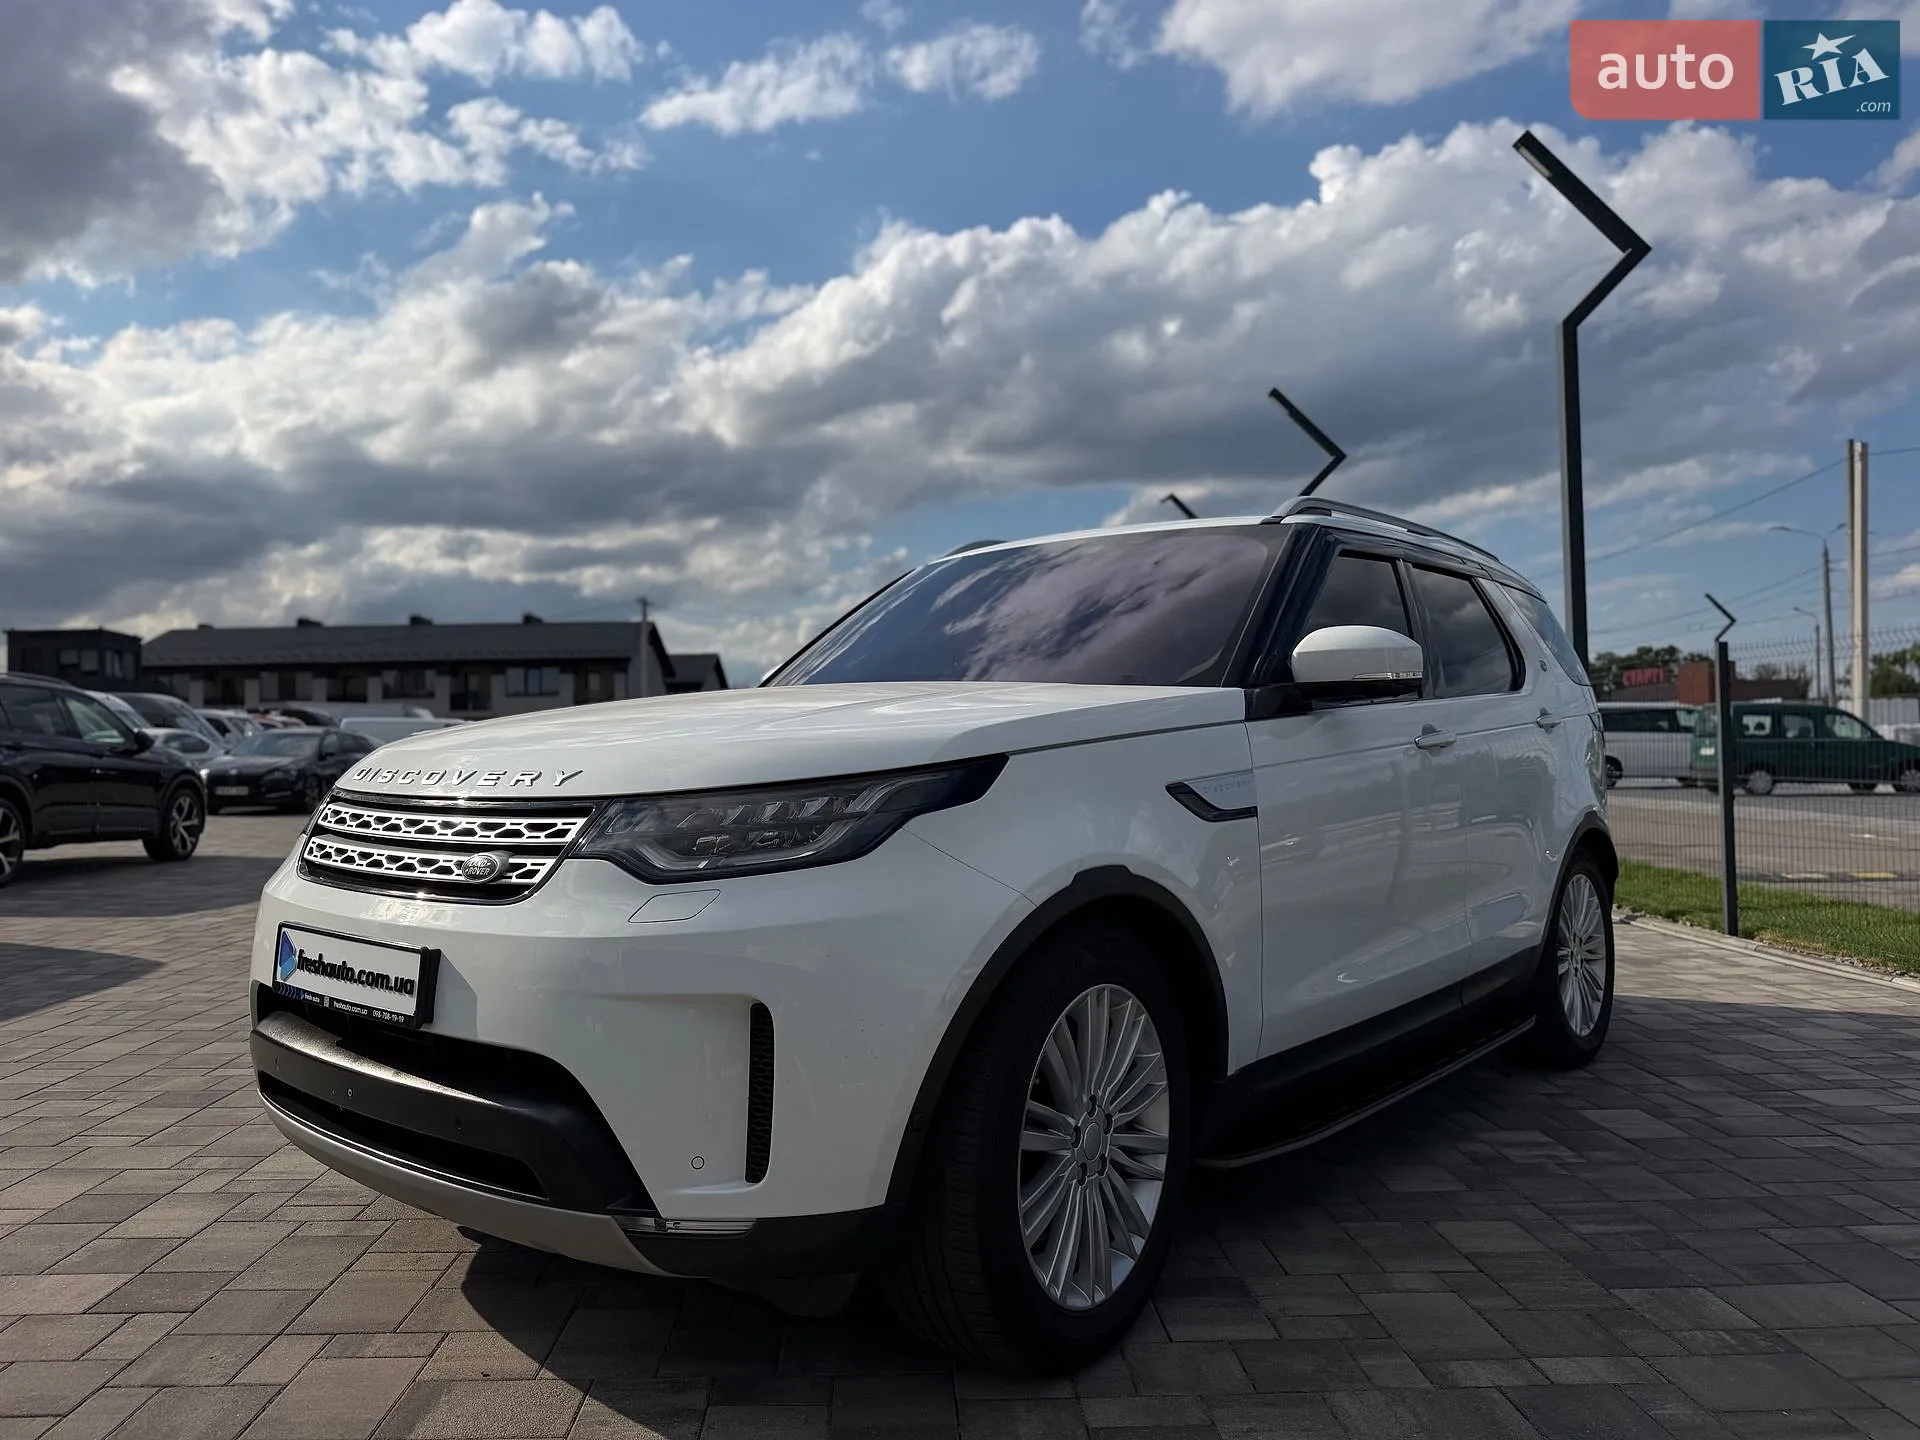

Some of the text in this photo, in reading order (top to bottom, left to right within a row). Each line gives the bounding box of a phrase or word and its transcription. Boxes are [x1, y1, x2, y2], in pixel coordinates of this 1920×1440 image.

[352, 767, 585, 787] DISCOVERY
[467, 858, 488, 867] LAND
[467, 867, 490, 876] ROVER
[297, 949, 415, 995] freshauto.com.ua
